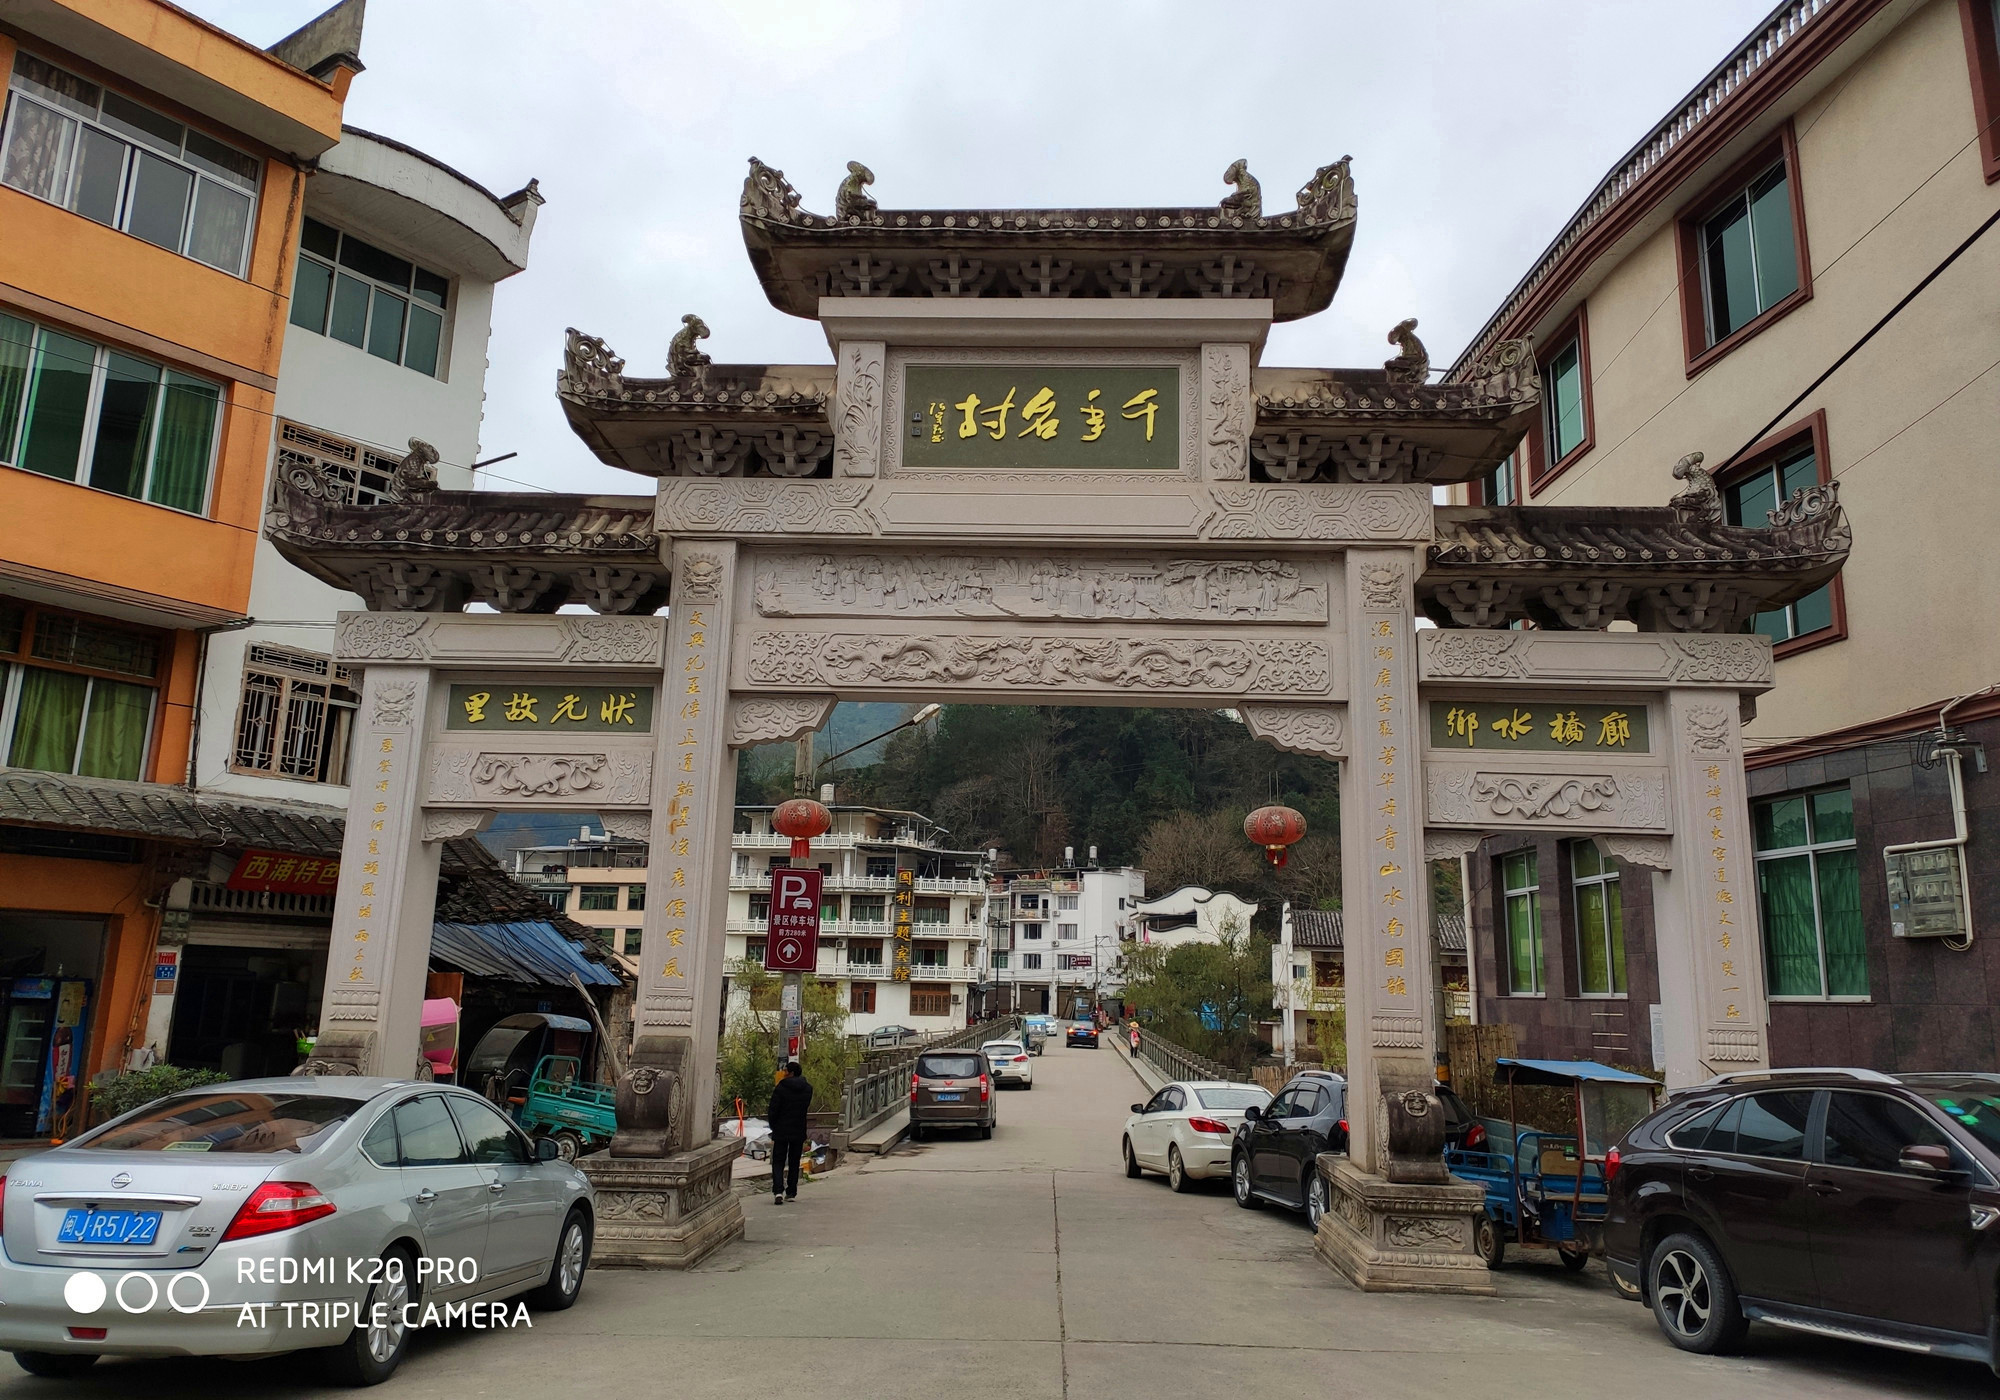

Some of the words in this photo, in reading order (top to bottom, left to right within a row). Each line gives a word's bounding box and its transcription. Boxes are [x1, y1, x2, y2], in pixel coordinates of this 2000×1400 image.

[242, 856, 340, 885] 西浦特色
[779, 876, 807, 909] P
[773, 914, 816, 927] 景区停车场
[894, 870, 913, 982] 国利主题宾馆
[10, 1179, 44, 1187] TEANA
